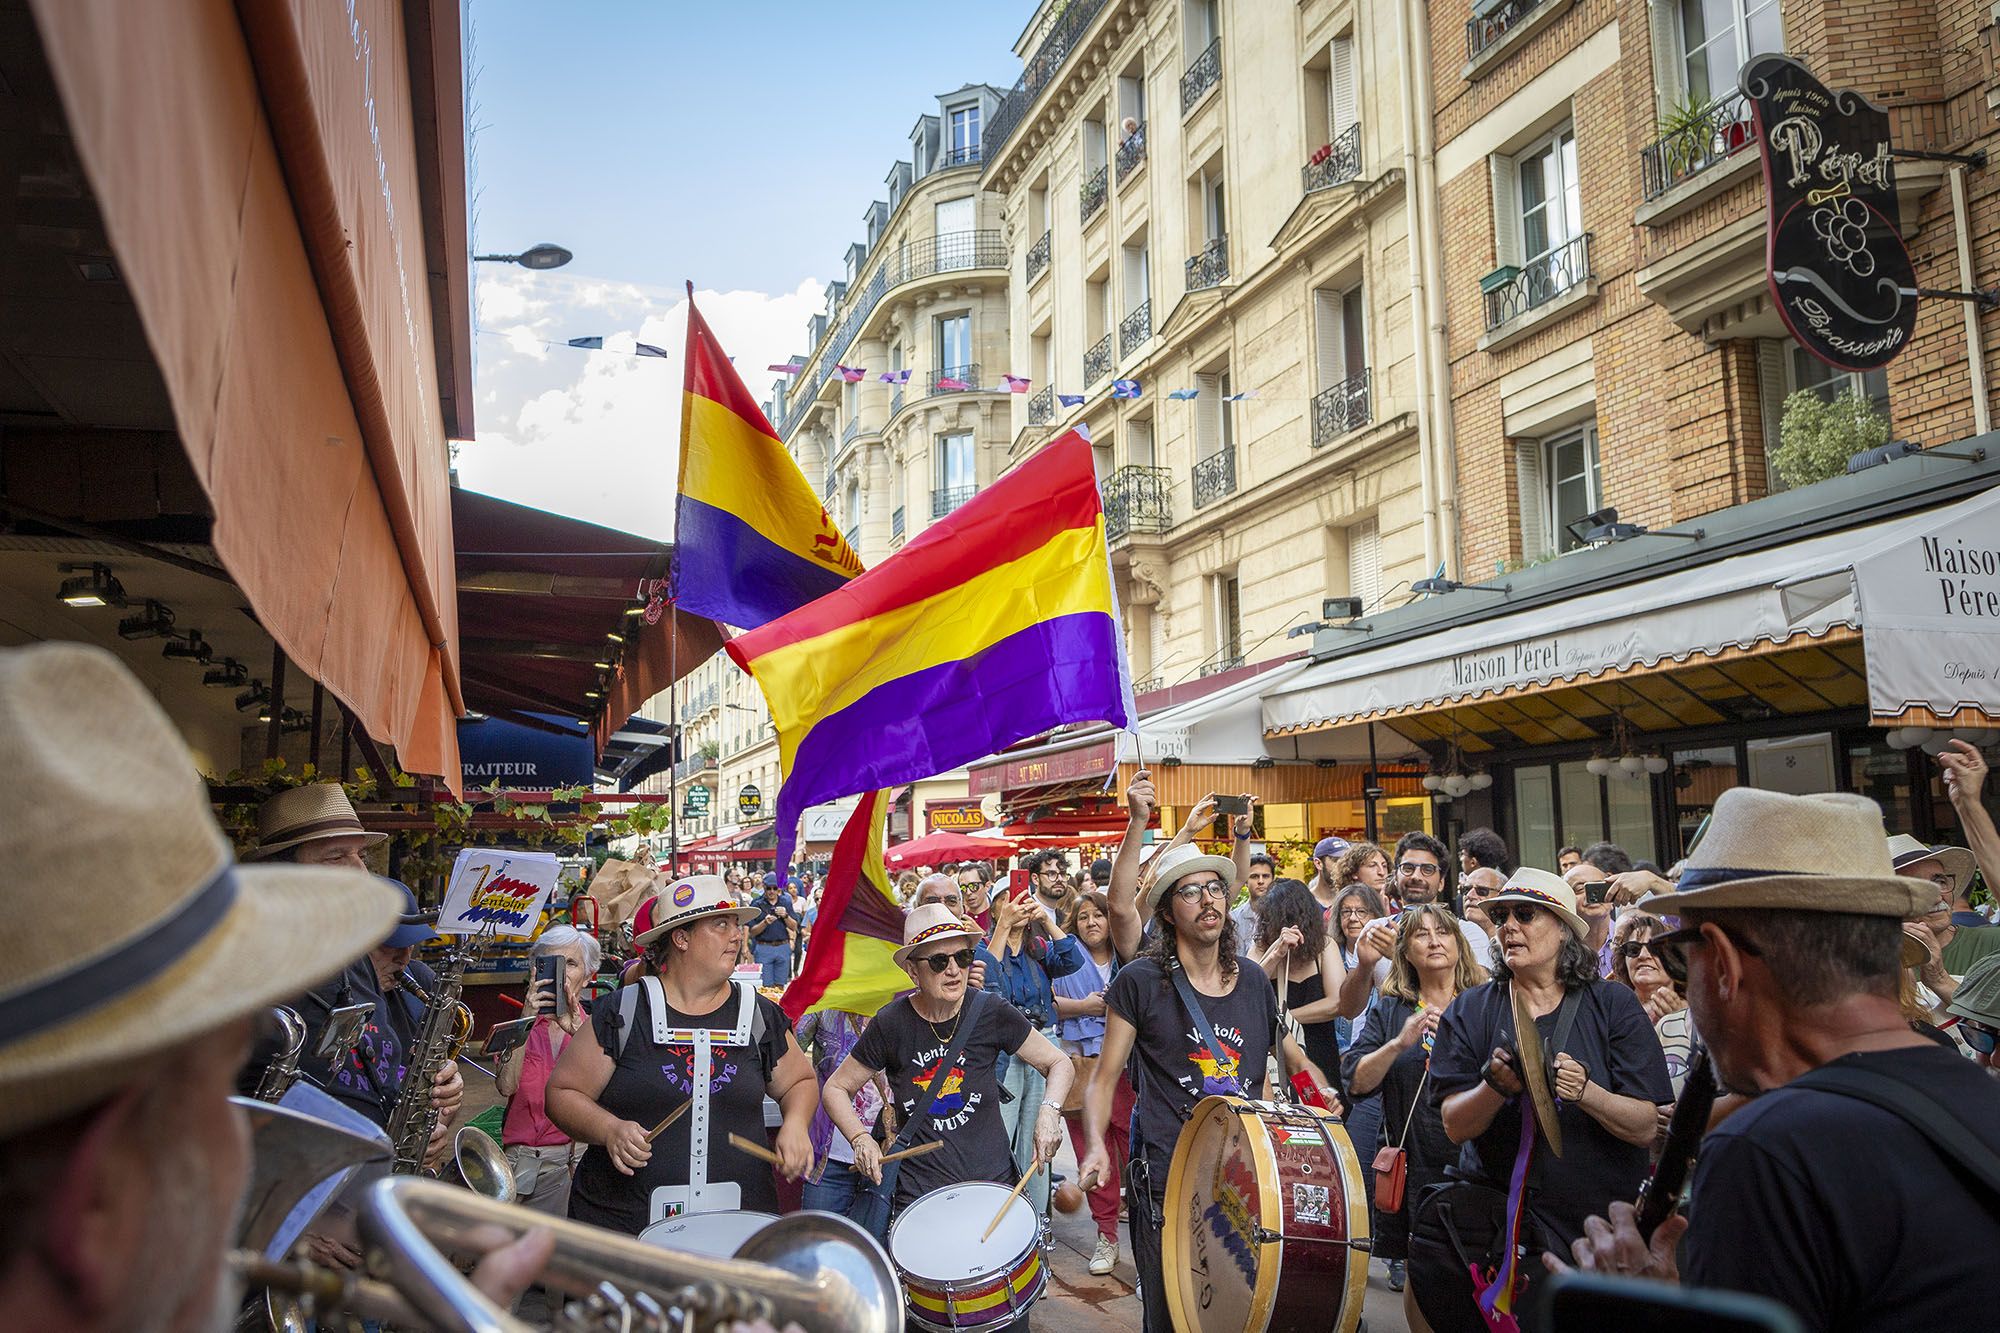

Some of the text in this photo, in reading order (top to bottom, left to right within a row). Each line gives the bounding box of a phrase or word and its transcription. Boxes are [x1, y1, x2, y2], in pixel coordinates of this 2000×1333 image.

[1785, 100, 1821, 116] Maison
[1805, 90, 1830, 107] 1908
[1770, 114, 1895, 190] Péret
[1790, 296, 1903, 357] Brasserie
[1920, 536, 2000, 576] Maiso
[1939, 578, 2000, 617] Pére
[1452, 639, 1630, 687] Maison Péret Depuis 1908
[1943, 662, 1986, 685] Depuis
[934, 812, 981, 825] NICOLAS
[680, 1063, 738, 1095] NEVE
[933, 1092, 982, 1131] NUEVE
